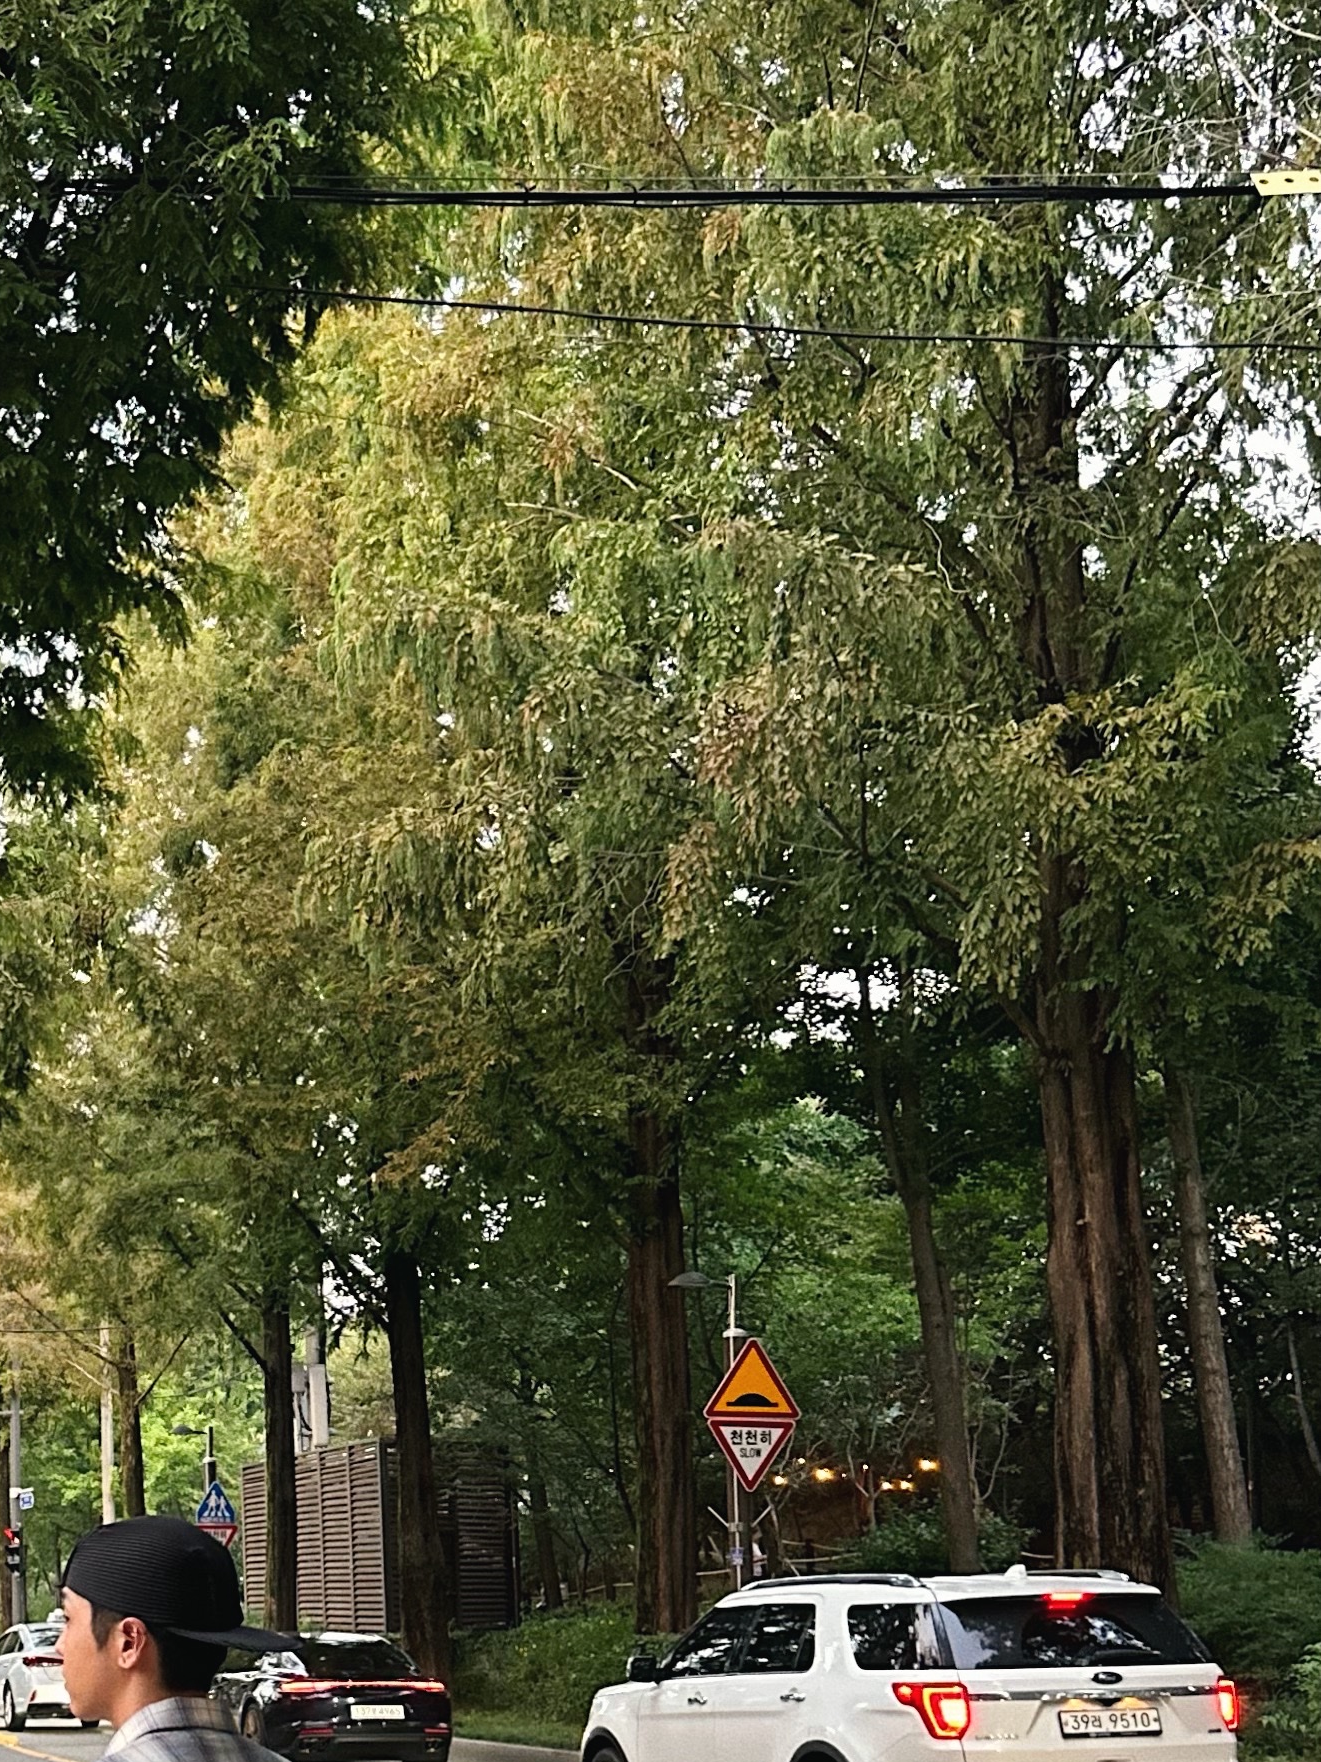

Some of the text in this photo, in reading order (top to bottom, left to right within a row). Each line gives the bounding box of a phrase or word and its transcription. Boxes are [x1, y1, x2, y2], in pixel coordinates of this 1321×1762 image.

[730, 1430, 772, 1445] 천천히
[739, 1448, 762, 1458] SLOW
[1109, 1712, 1151, 1729] 9510
